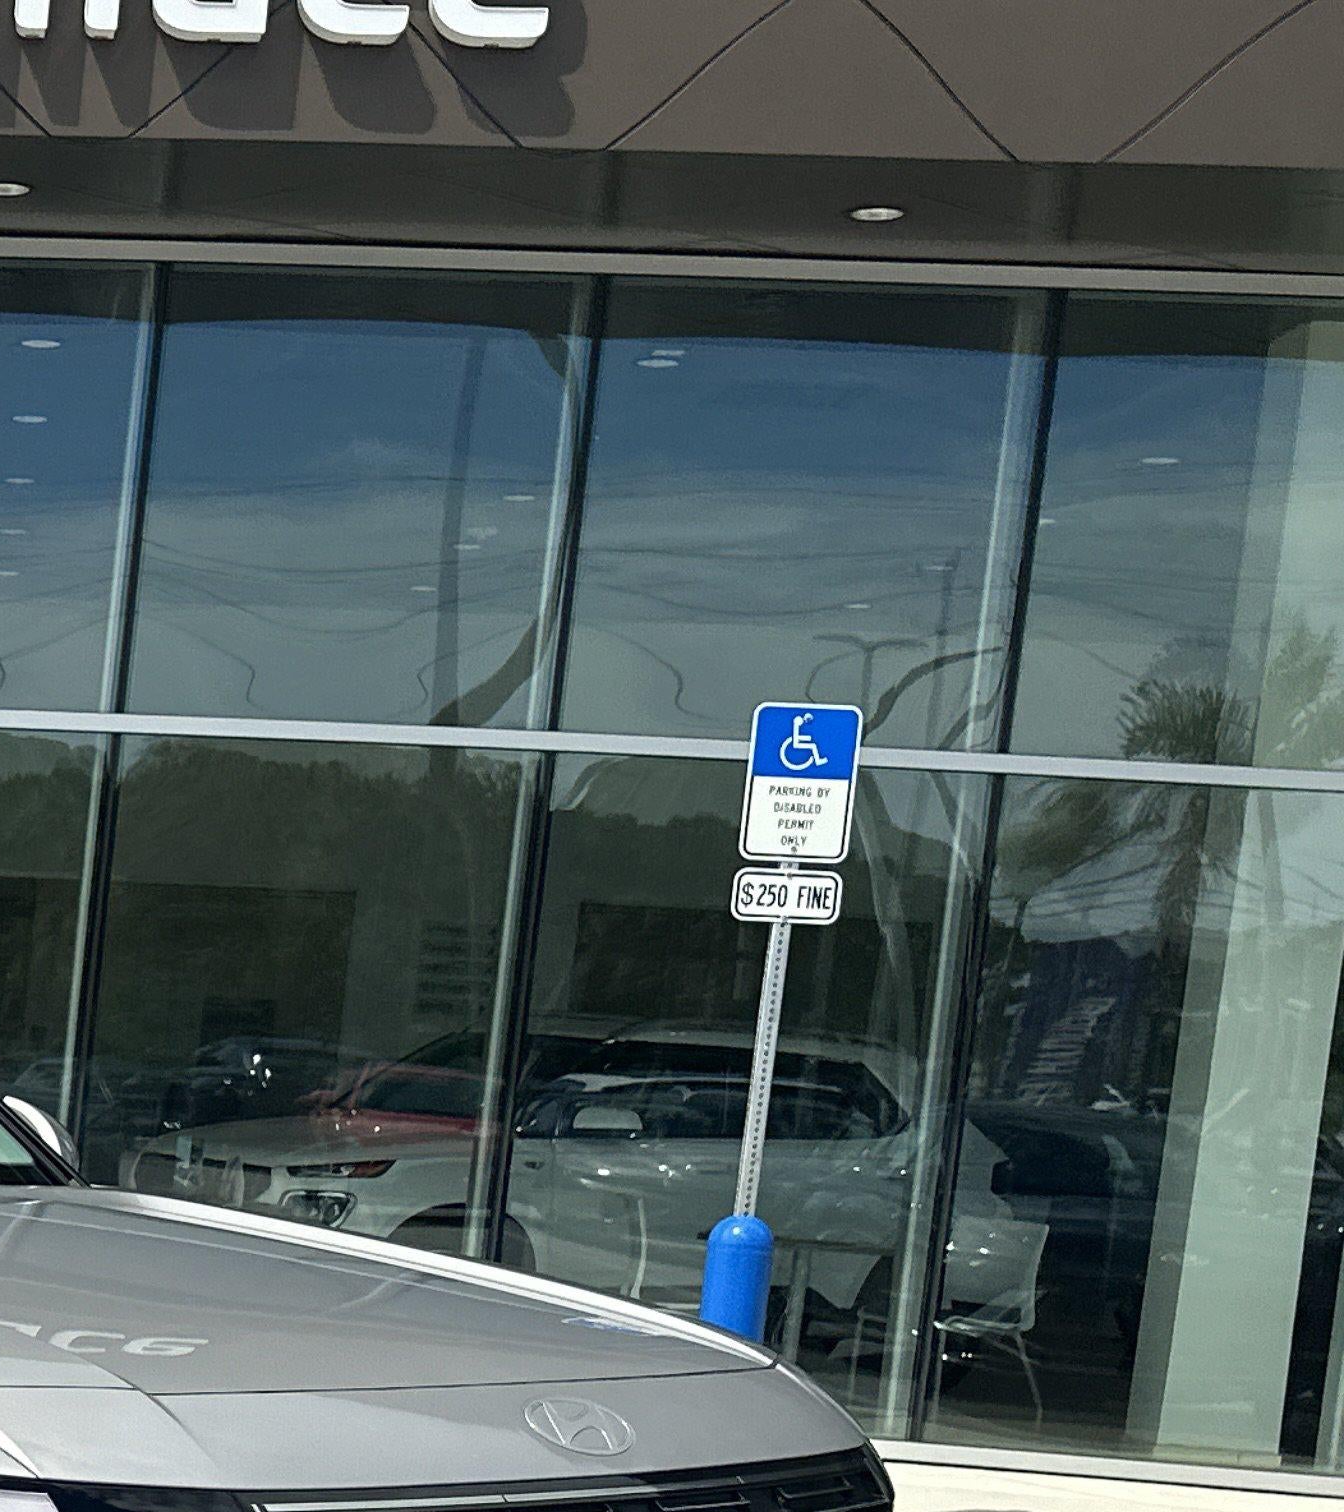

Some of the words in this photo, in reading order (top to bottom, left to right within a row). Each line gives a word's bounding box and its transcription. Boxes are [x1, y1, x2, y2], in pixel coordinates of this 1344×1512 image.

[769, 785, 812, 797] PARKING
[817, 787, 831, 798] BY
[773, 802, 822, 814] DISABLED
[777, 818, 815, 830] PERMIT
[781, 835, 807, 846] ONLY
[741, 882, 788, 908] $250
[797, 885, 832, 910] FINE
